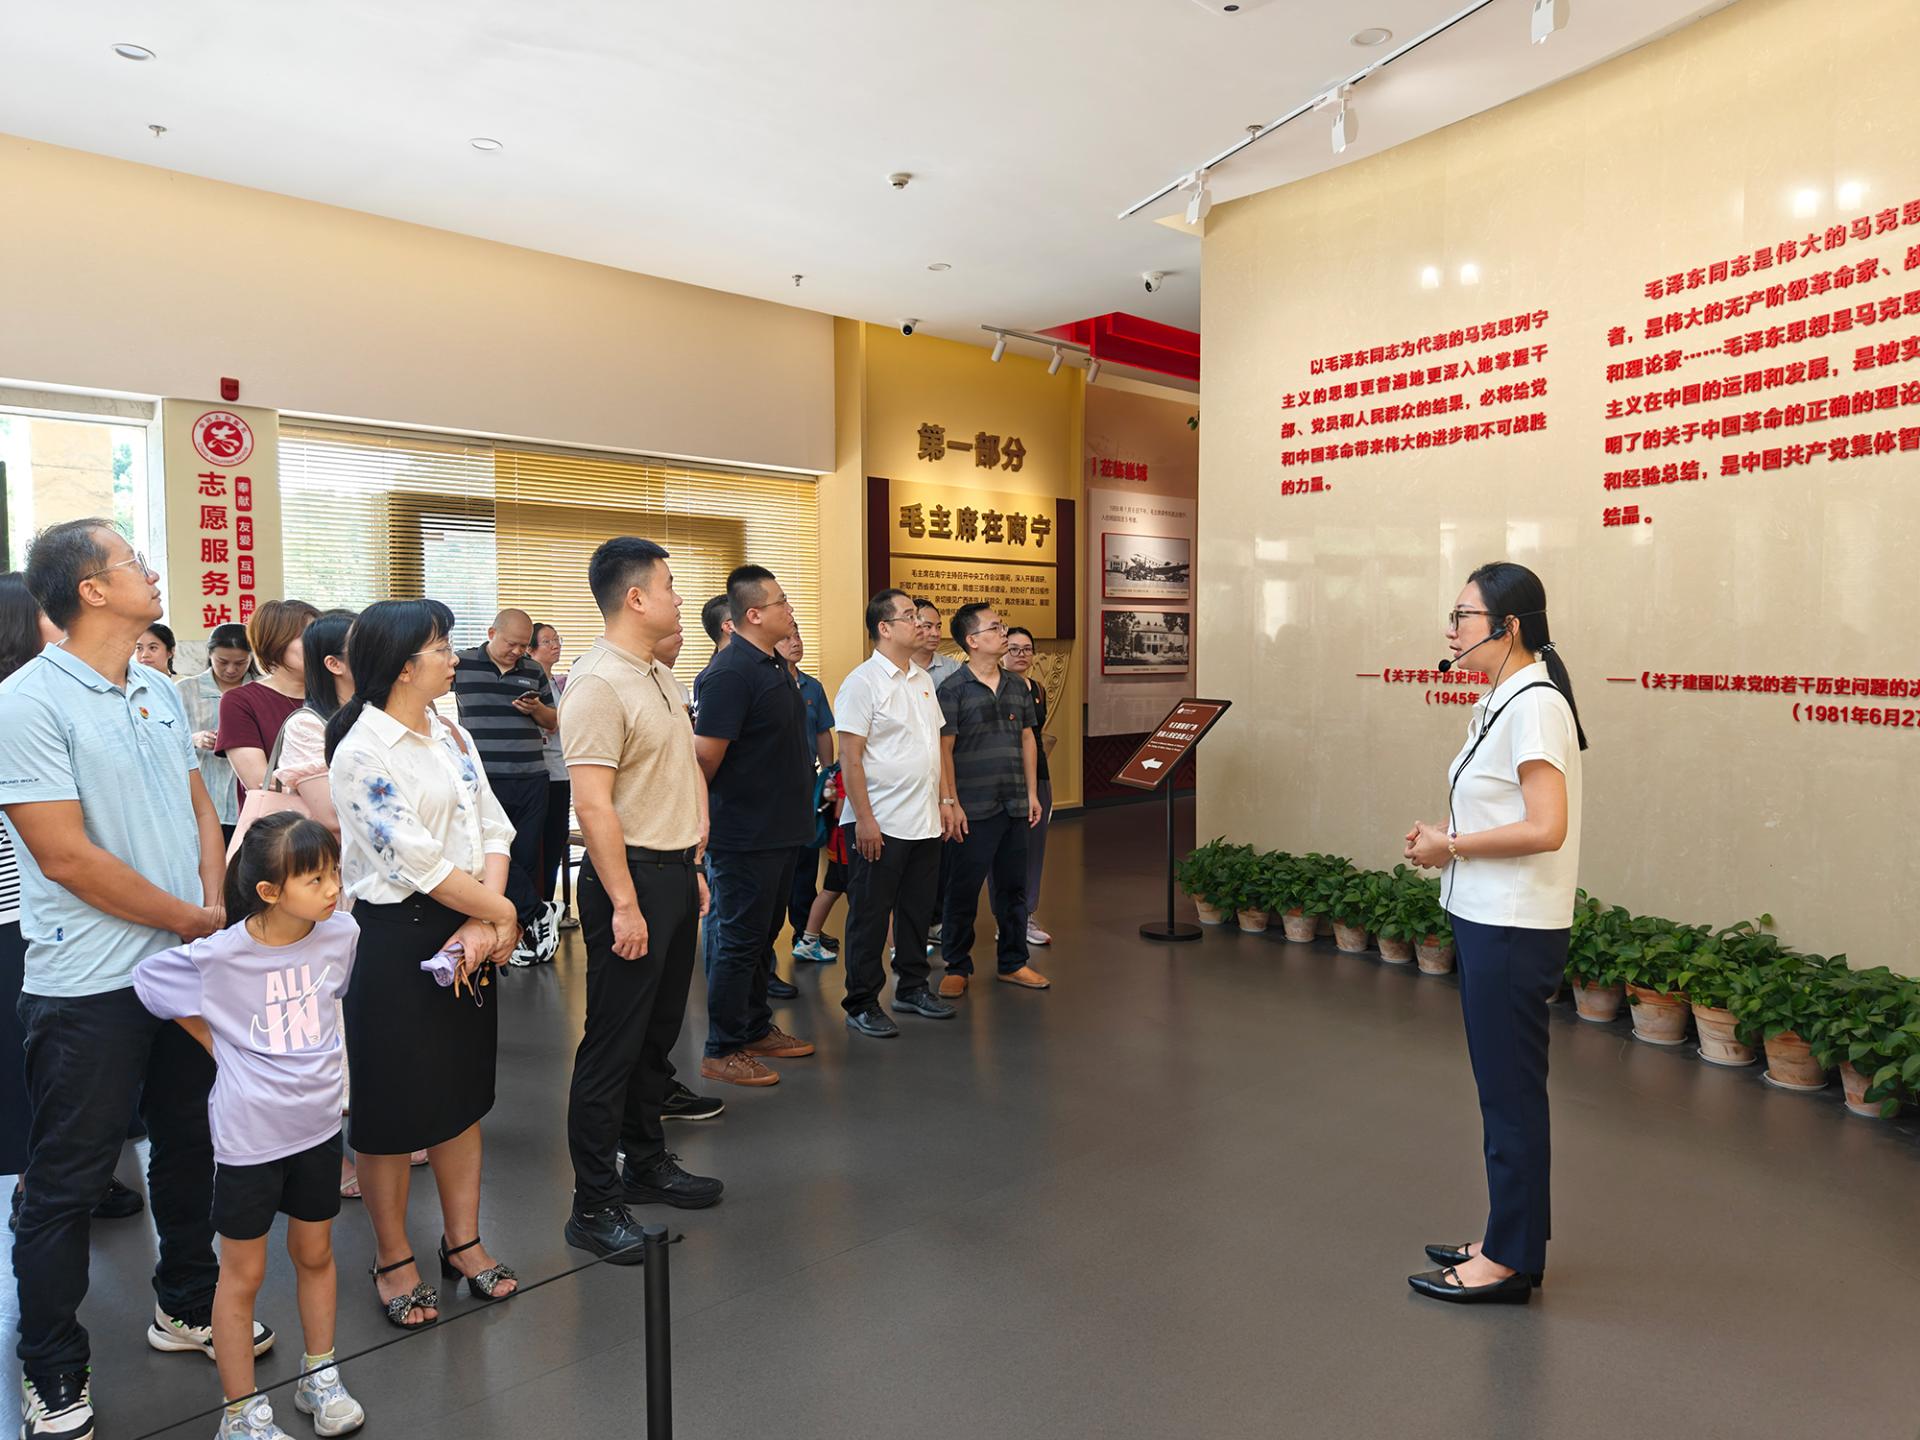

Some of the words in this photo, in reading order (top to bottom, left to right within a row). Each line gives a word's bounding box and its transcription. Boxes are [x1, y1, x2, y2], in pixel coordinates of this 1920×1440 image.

[1644, 198, 1920, 301] 毛泽东同志是伟大的马克思
[1310, 309, 1549, 375] 以毛泽东同志为代表的马克思列宁
[1281, 344, 1549, 409] 主义的思想更普遍地更深入地掌握干
[1605, 335, 1920, 420] 主义在中国的运用和发展，是被实
[1280, 377, 1548, 440] 部、党员和人民群众的结果，必将给党
[1604, 380, 1920, 455] 明了的关于中国革命的正确的理论
[917, 422, 1027, 473] 第一部分
[1281, 412, 1548, 467] 和中国革命带来伟大的进步和不可战胜
[1603, 426, 1920, 492] 和经验总结，是中国共产党集体智
[237, 482, 250, 507] 奉献
[1280, 476, 1333, 496] 的力量。
[239, 521, 251, 546] 友爱
[899, 502, 1052, 548] 毛主席在南宁
[1602, 505, 1652, 527] 结晶。
[198, 471, 232, 629] 志愿服务站
[240, 561, 252, 585] 互助
[265, 964, 316, 1006] ALL
[265, 995, 321, 1054] IN
